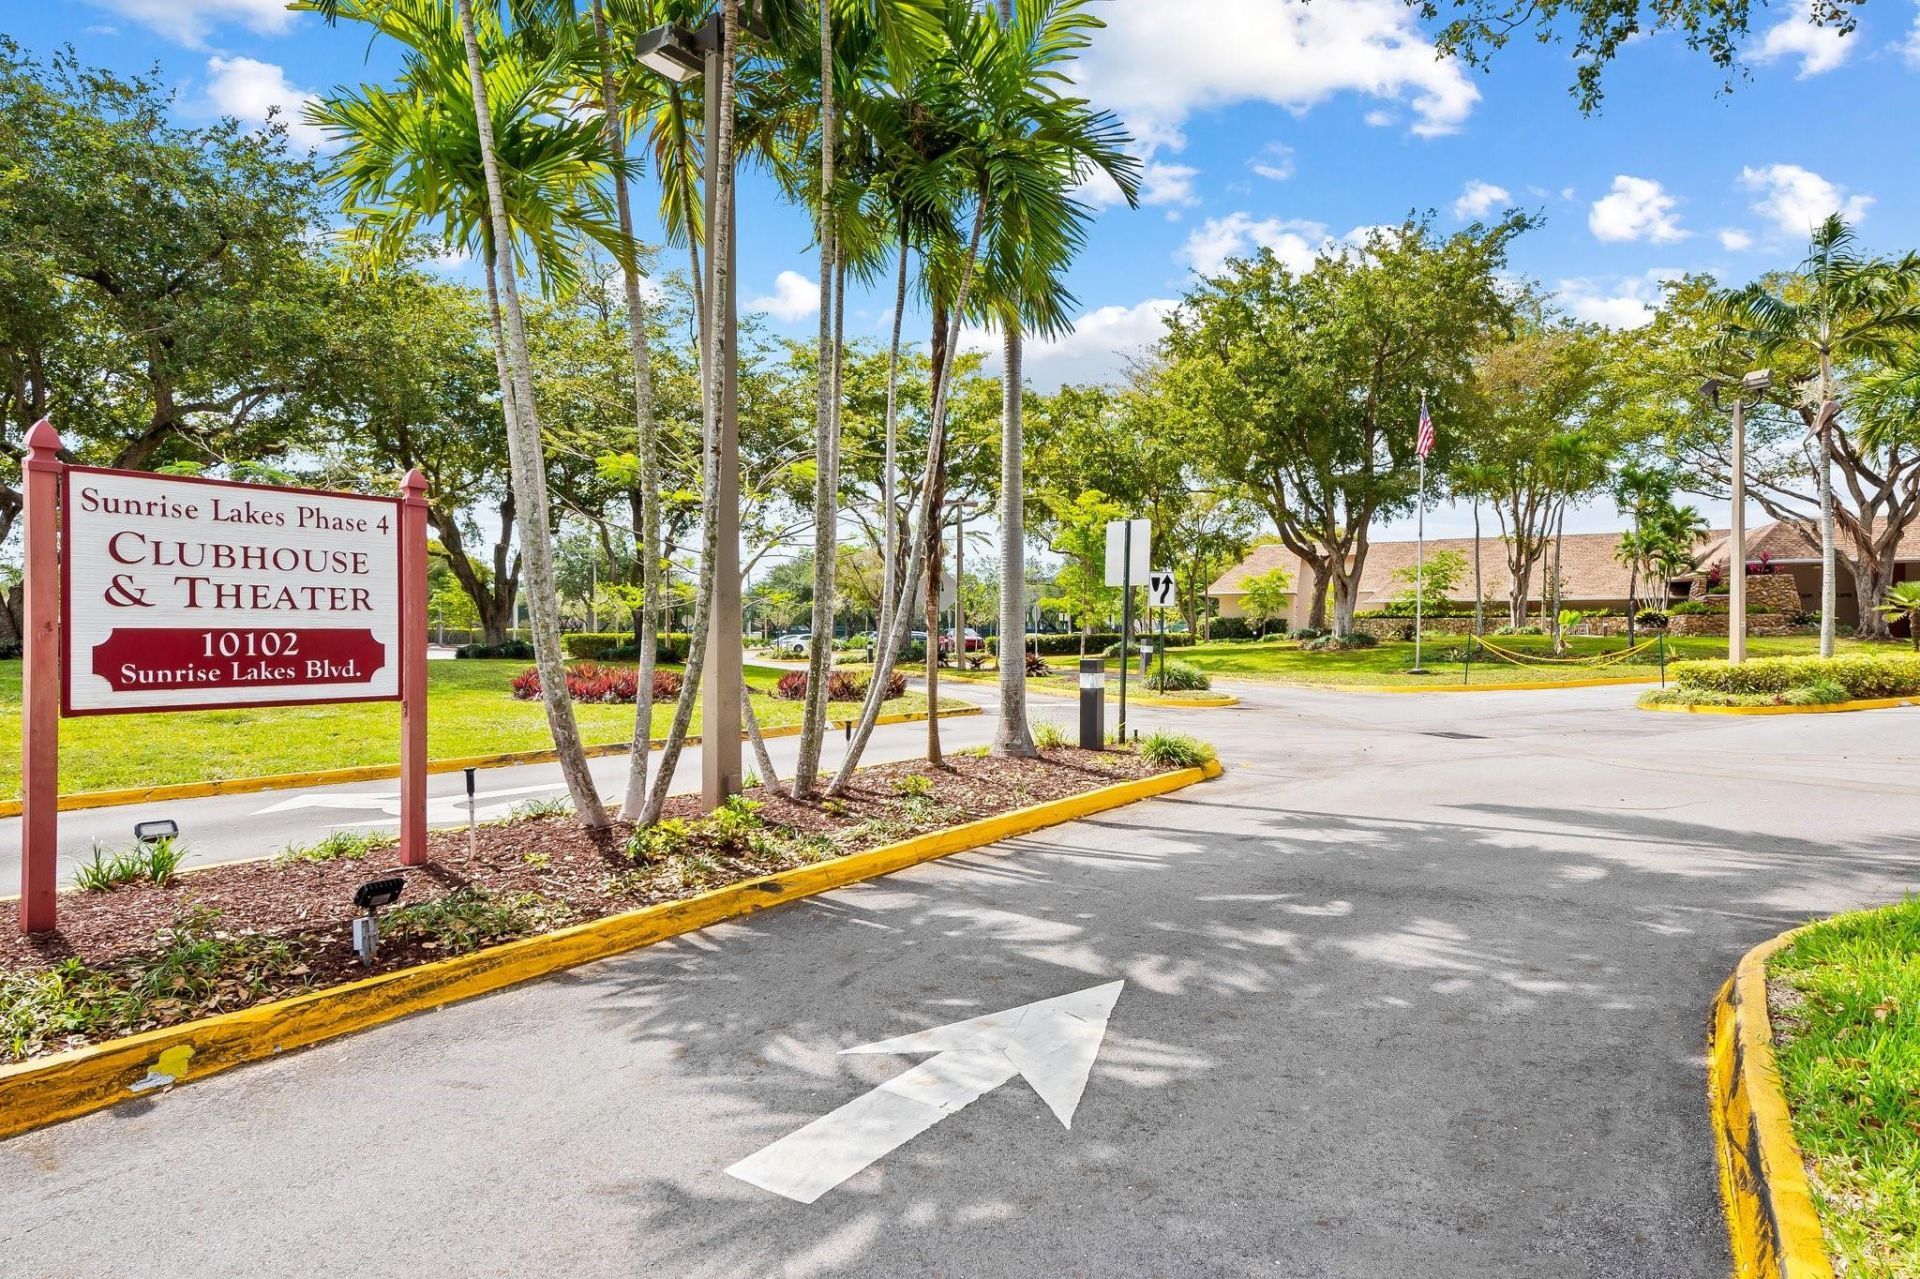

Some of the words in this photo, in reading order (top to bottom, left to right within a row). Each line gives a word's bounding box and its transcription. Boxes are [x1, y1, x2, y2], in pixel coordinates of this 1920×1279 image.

[81, 487, 199, 520] Sunrise
[211, 498, 286, 527] Lakes
[297, 506, 368, 533] Phase
[376, 514, 390, 536] 4
[108, 530, 370, 575] CLUBHOUSE
[104, 573, 156, 608] &
[173, 576, 374, 611] THEATER
[202, 632, 300, 658] 10102
[121, 662, 221, 684] Sunrise
[231, 661, 296, 681] Lakes
[305, 658, 362, 679] Blvd.
